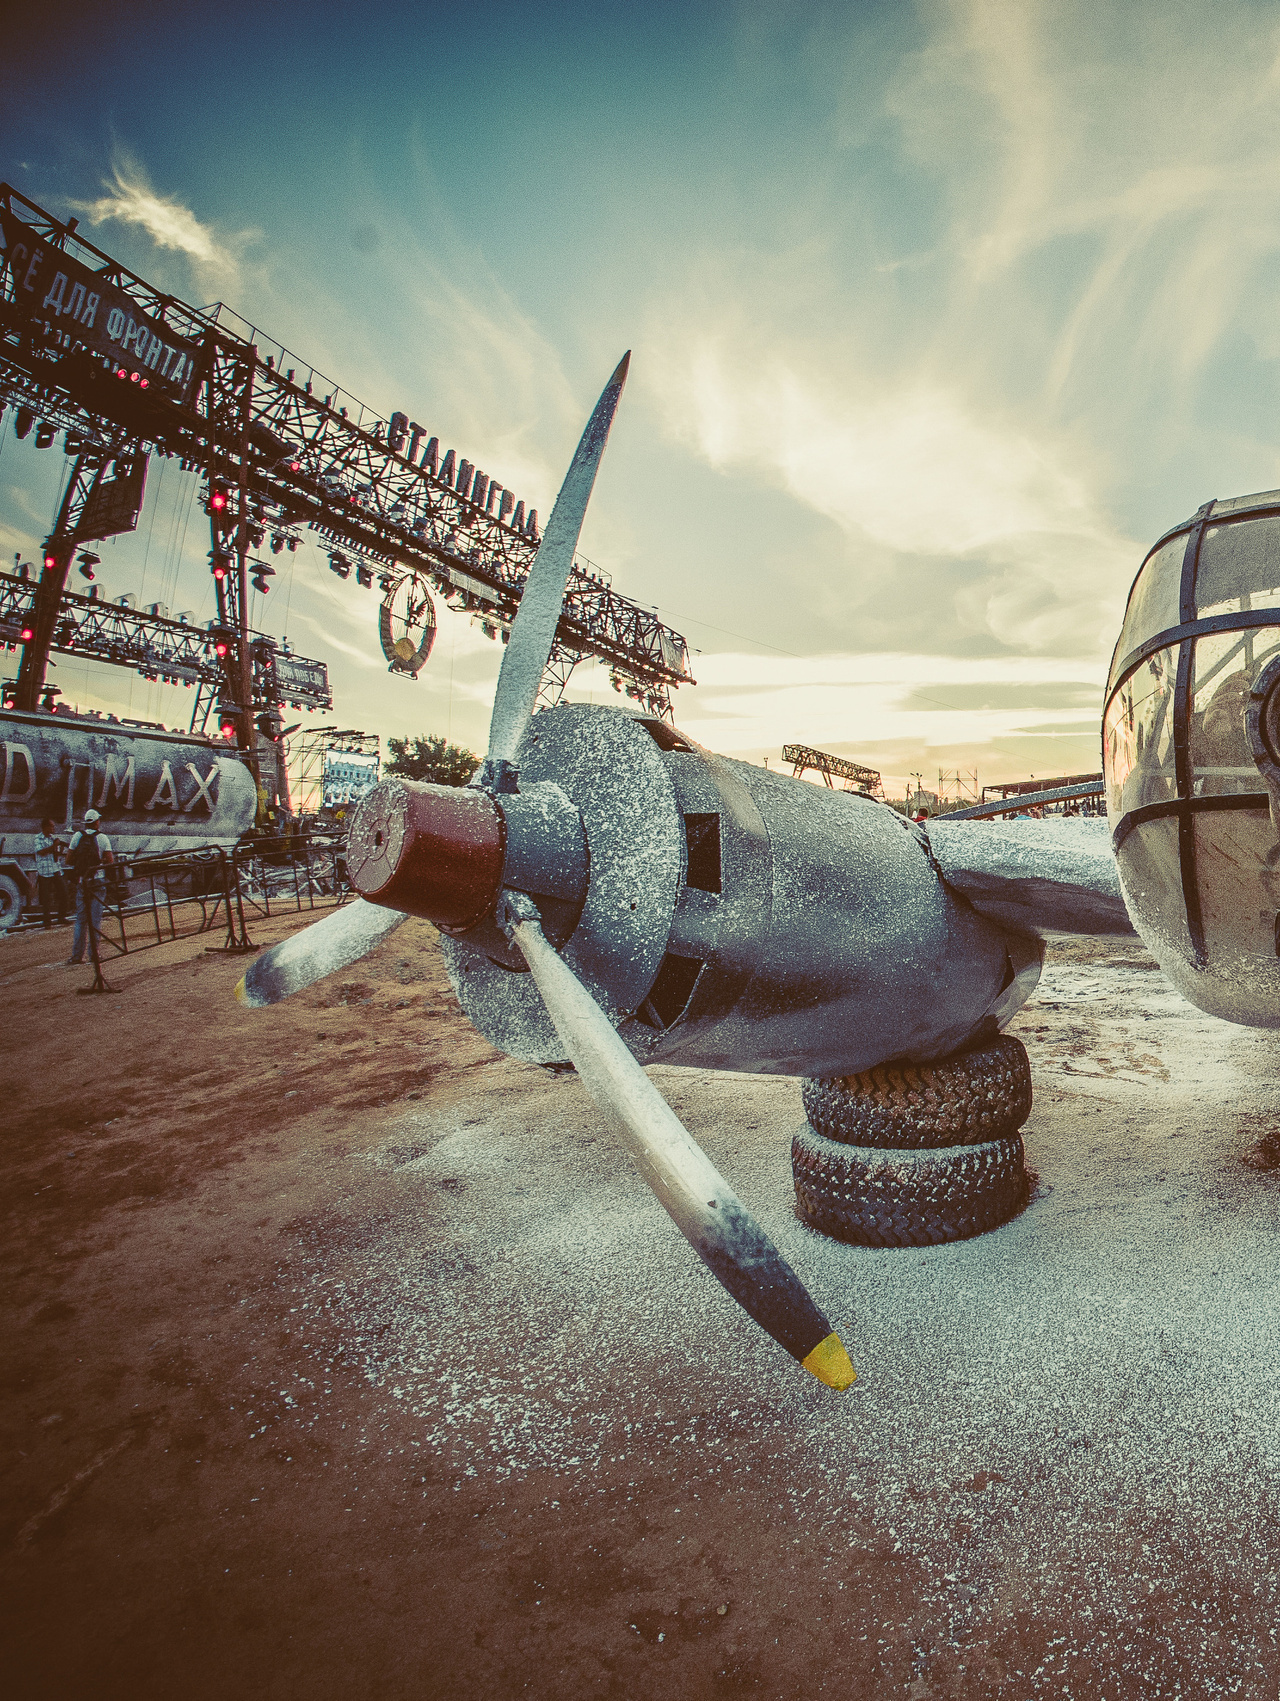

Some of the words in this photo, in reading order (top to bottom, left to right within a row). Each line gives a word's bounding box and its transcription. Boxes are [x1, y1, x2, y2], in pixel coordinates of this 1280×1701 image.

[42, 271, 101, 328] ДЛЯ
[106, 307, 194, 390] ФРОНТА!
[387, 411, 541, 543] СТАЛИНГРАД
[95, 753, 221, 813] MAX
